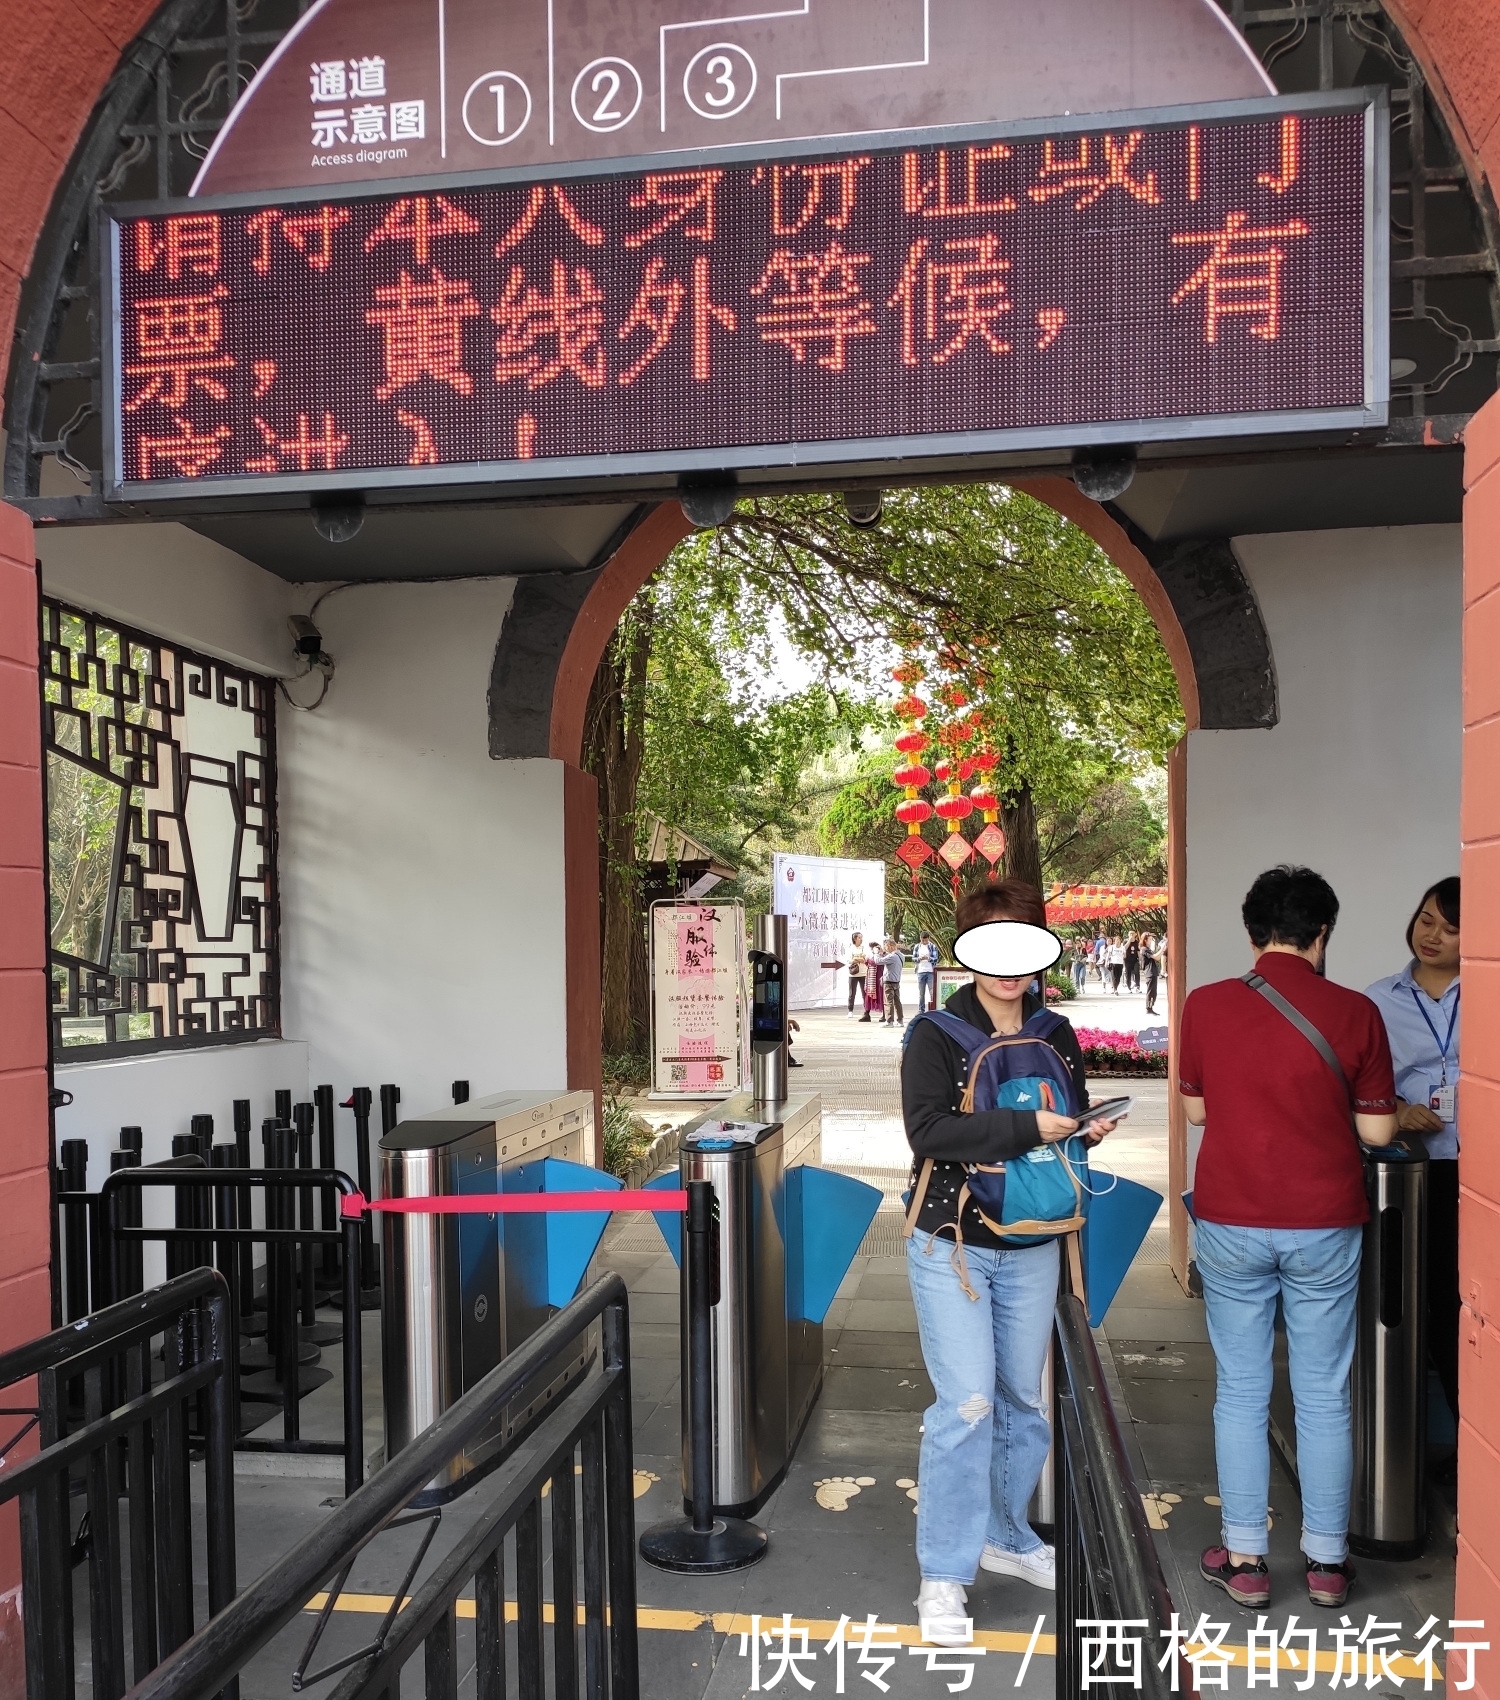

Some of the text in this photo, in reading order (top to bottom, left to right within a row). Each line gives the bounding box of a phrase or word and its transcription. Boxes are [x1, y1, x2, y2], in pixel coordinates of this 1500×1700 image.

[309, 55, 387, 104] 通道
[310, 99, 426, 149] 示意图
[311, 147, 408, 167] Access diagram
